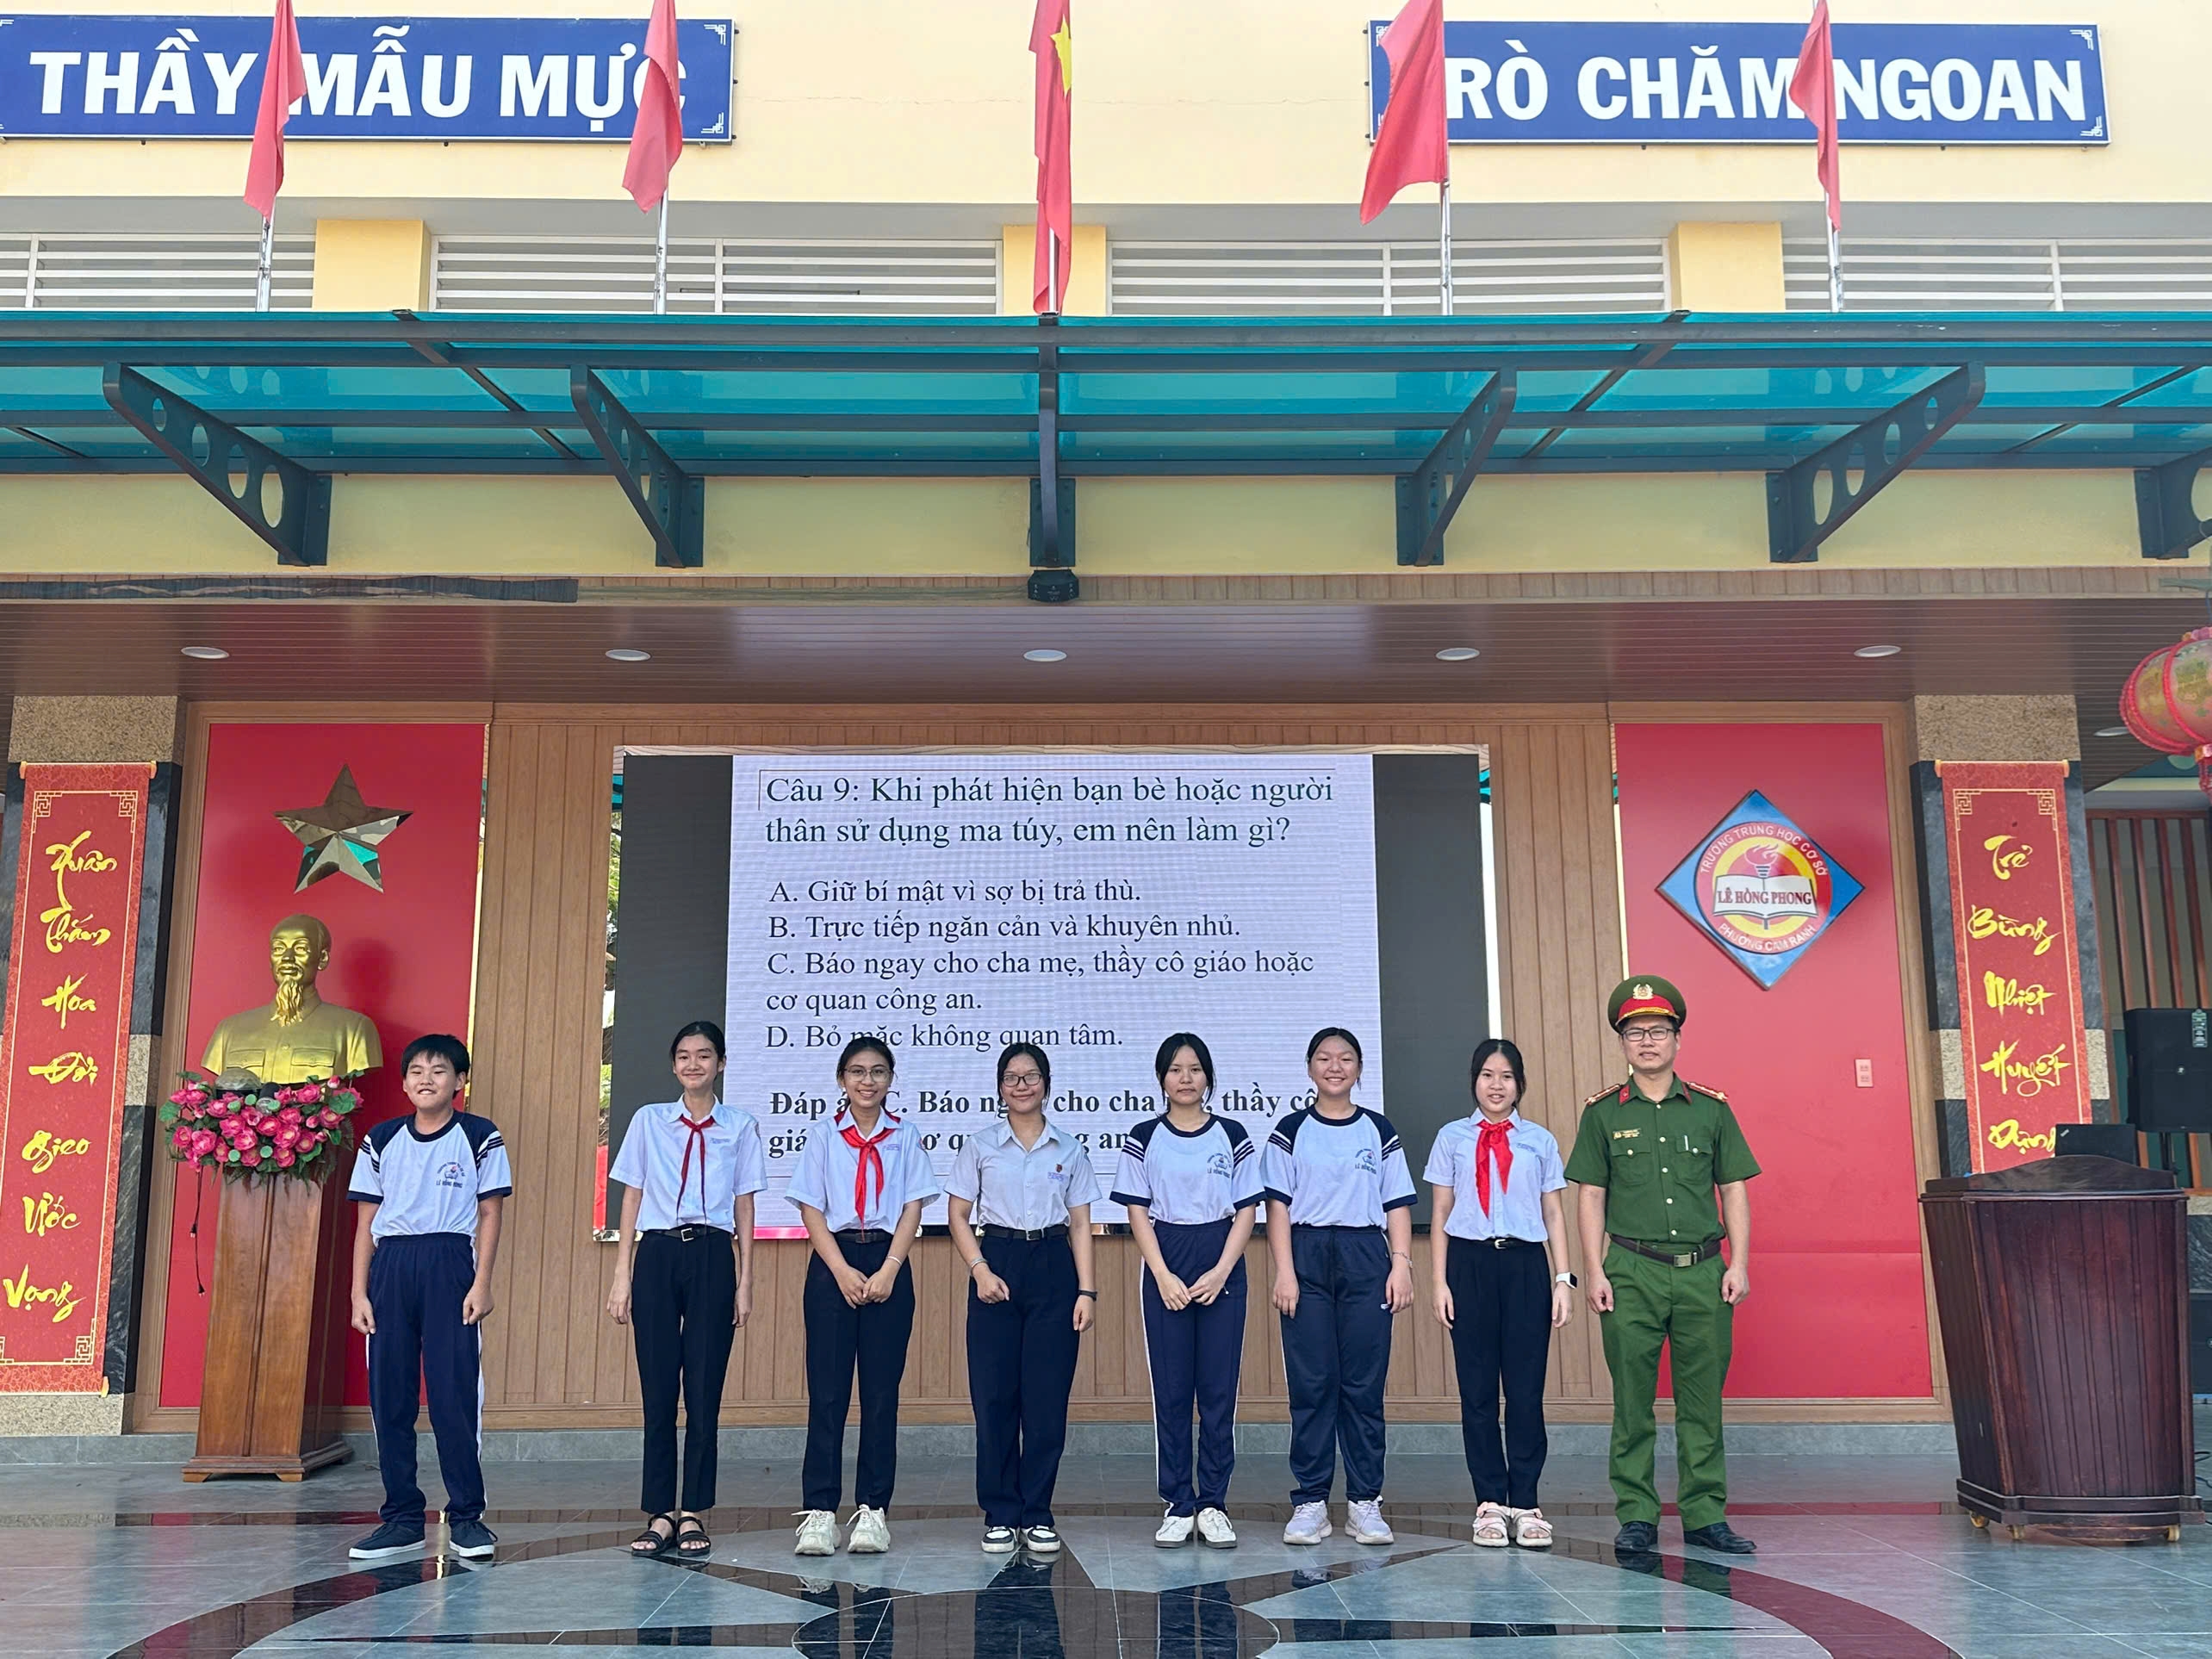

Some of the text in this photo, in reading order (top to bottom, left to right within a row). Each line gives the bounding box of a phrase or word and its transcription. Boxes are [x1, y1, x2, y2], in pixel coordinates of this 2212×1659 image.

[29, 28, 258, 115] THẦY
[289, 25, 473, 117] MẪU
[1445, 40, 2086, 122] RÒ CHĂM NGOAN
[767, 775, 1333, 809] Câu 9: Khi phát hiện bạn bè hoặc người
[765, 816, 1290, 849] thân sử dụng ma túy, em nên làm gì?
[1733, 824, 1774, 840] TRUNG
[46, 830, 117, 911] Xuân
[1984, 834, 2033, 880] Trẻ
[768, 878, 1140, 905] A. Giữ bí mật vì sợ bị trả thù.
[1718, 887, 1733, 904] LÊ
[1771, 892, 1812, 905] PHONG
[40, 906, 111, 954] Thắm
[768, 909, 1240, 944] B. Trực tiếp ngăn cản và khuyên nhủ.
[1788, 924, 1816, 946] RANH
[767, 944, 1314, 980] C. Báo ngay cho cha mẹ, thầy cô giáo hoặc
[41, 974, 96, 1029] Hoa
[766, 987, 982, 1016] cơ quan công an.
[1984, 970, 2056, 1017] Nhiệt
[766, 1026, 794, 1047] D.
[805, 1024, 842, 1047] Bỏ
[911, 1023, 991, 1053] không
[999, 1029, 1061, 1047] quan
[1068, 1022, 1123, 1046] tâm.
[1980, 1039, 2072, 1097] Huyết
[769, 1091, 827, 1121] Đáp
[918, 1090, 970, 1113] Báo
[1053, 1090, 1100, 1112] cho
[1109, 1090, 1155, 1112] cha
[1221, 1081, 1282, 1118] thầy
[22, 1130, 90, 1174] Gieo
[768, 1128, 807, 1159] giá
[3, 1264, 86, 1323] Vọng
